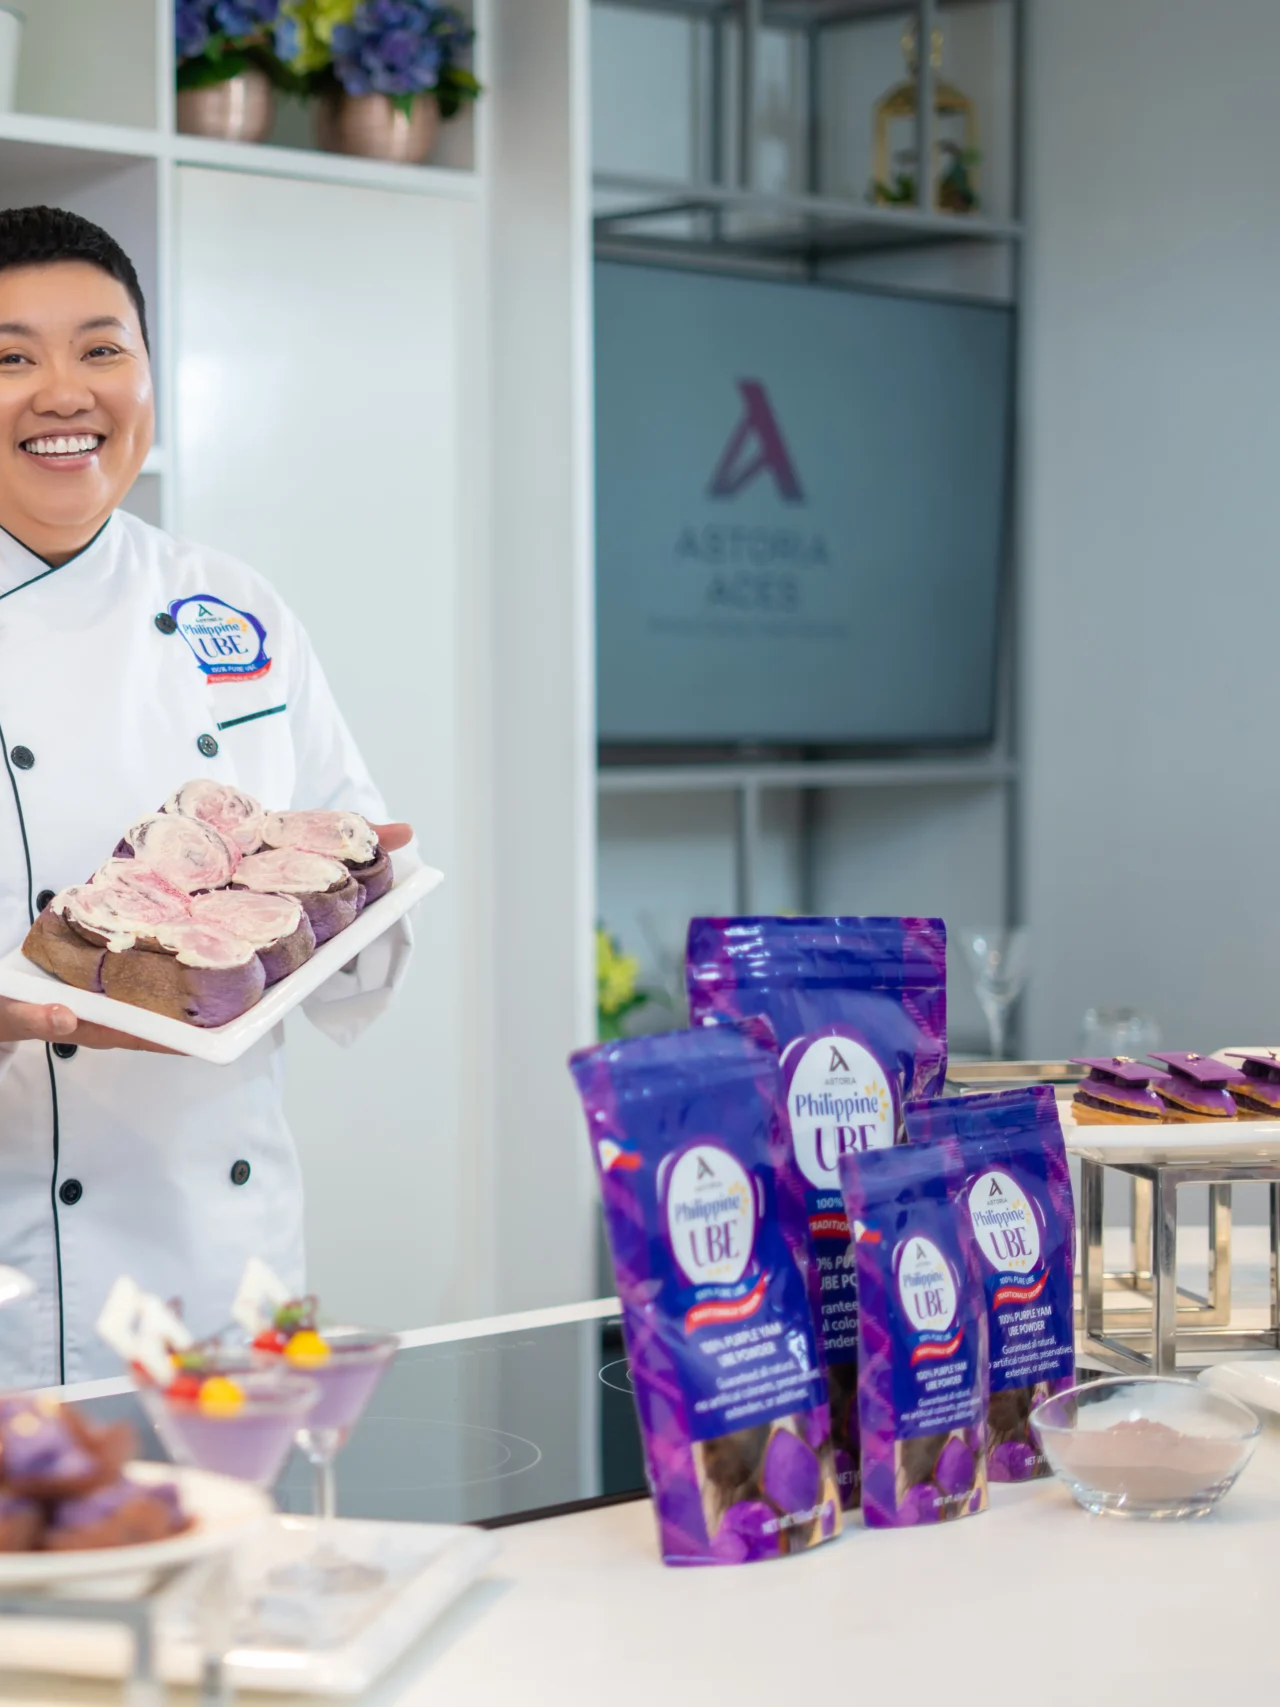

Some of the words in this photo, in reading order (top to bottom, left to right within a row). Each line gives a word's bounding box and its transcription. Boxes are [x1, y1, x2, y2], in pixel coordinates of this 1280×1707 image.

[182, 622, 240, 637] Philippine
[198, 635, 249, 658] UBE
[795, 1091, 879, 1123] Philippine
[816, 1197, 843, 1209] 100%
[972, 1207, 1025, 1229] Philippine
[689, 1219, 742, 1268] UBE
[989, 1226, 1032, 1261] UBE
[914, 1288, 949, 1320] UBE
[998, 1313, 1015, 1326] 100%
[1014, 1308, 1037, 1322] PURPLE
[1036, 1305, 1052, 1317] YAM
[1008, 1325, 1020, 1337] UBE
[1020, 1320, 1046, 1334] POWDER
[1002, 1340, 1031, 1355] Guaranteed
[993, 1357, 1017, 1369] artificial
[1024, 1456, 1036, 1467] NET
